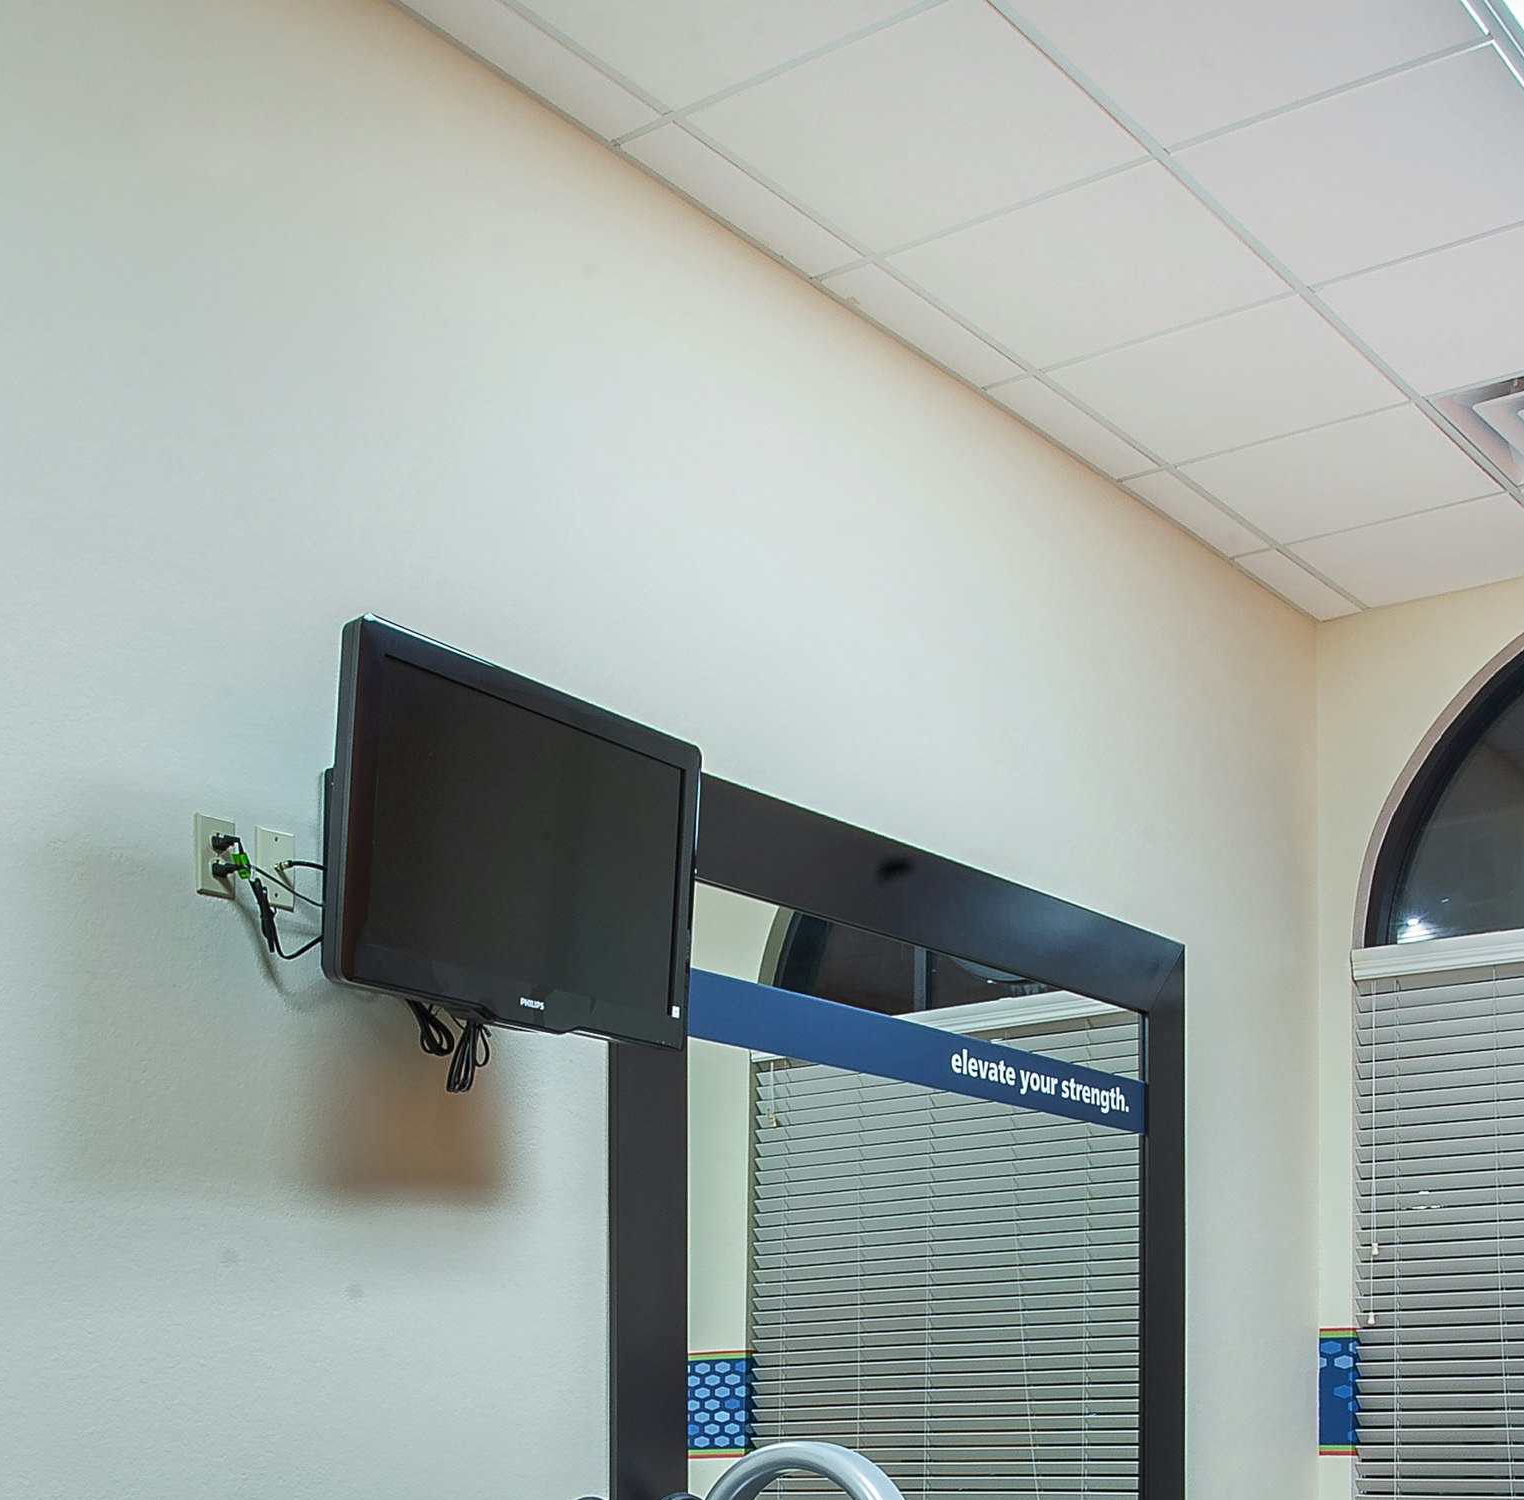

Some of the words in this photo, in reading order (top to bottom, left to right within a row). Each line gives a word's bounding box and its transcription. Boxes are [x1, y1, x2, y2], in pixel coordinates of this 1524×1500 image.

[951, 1049, 1016, 1086] elevate
[1019, 1069, 1059, 1095] your
[1061, 1080, 1130, 1114] strength.
